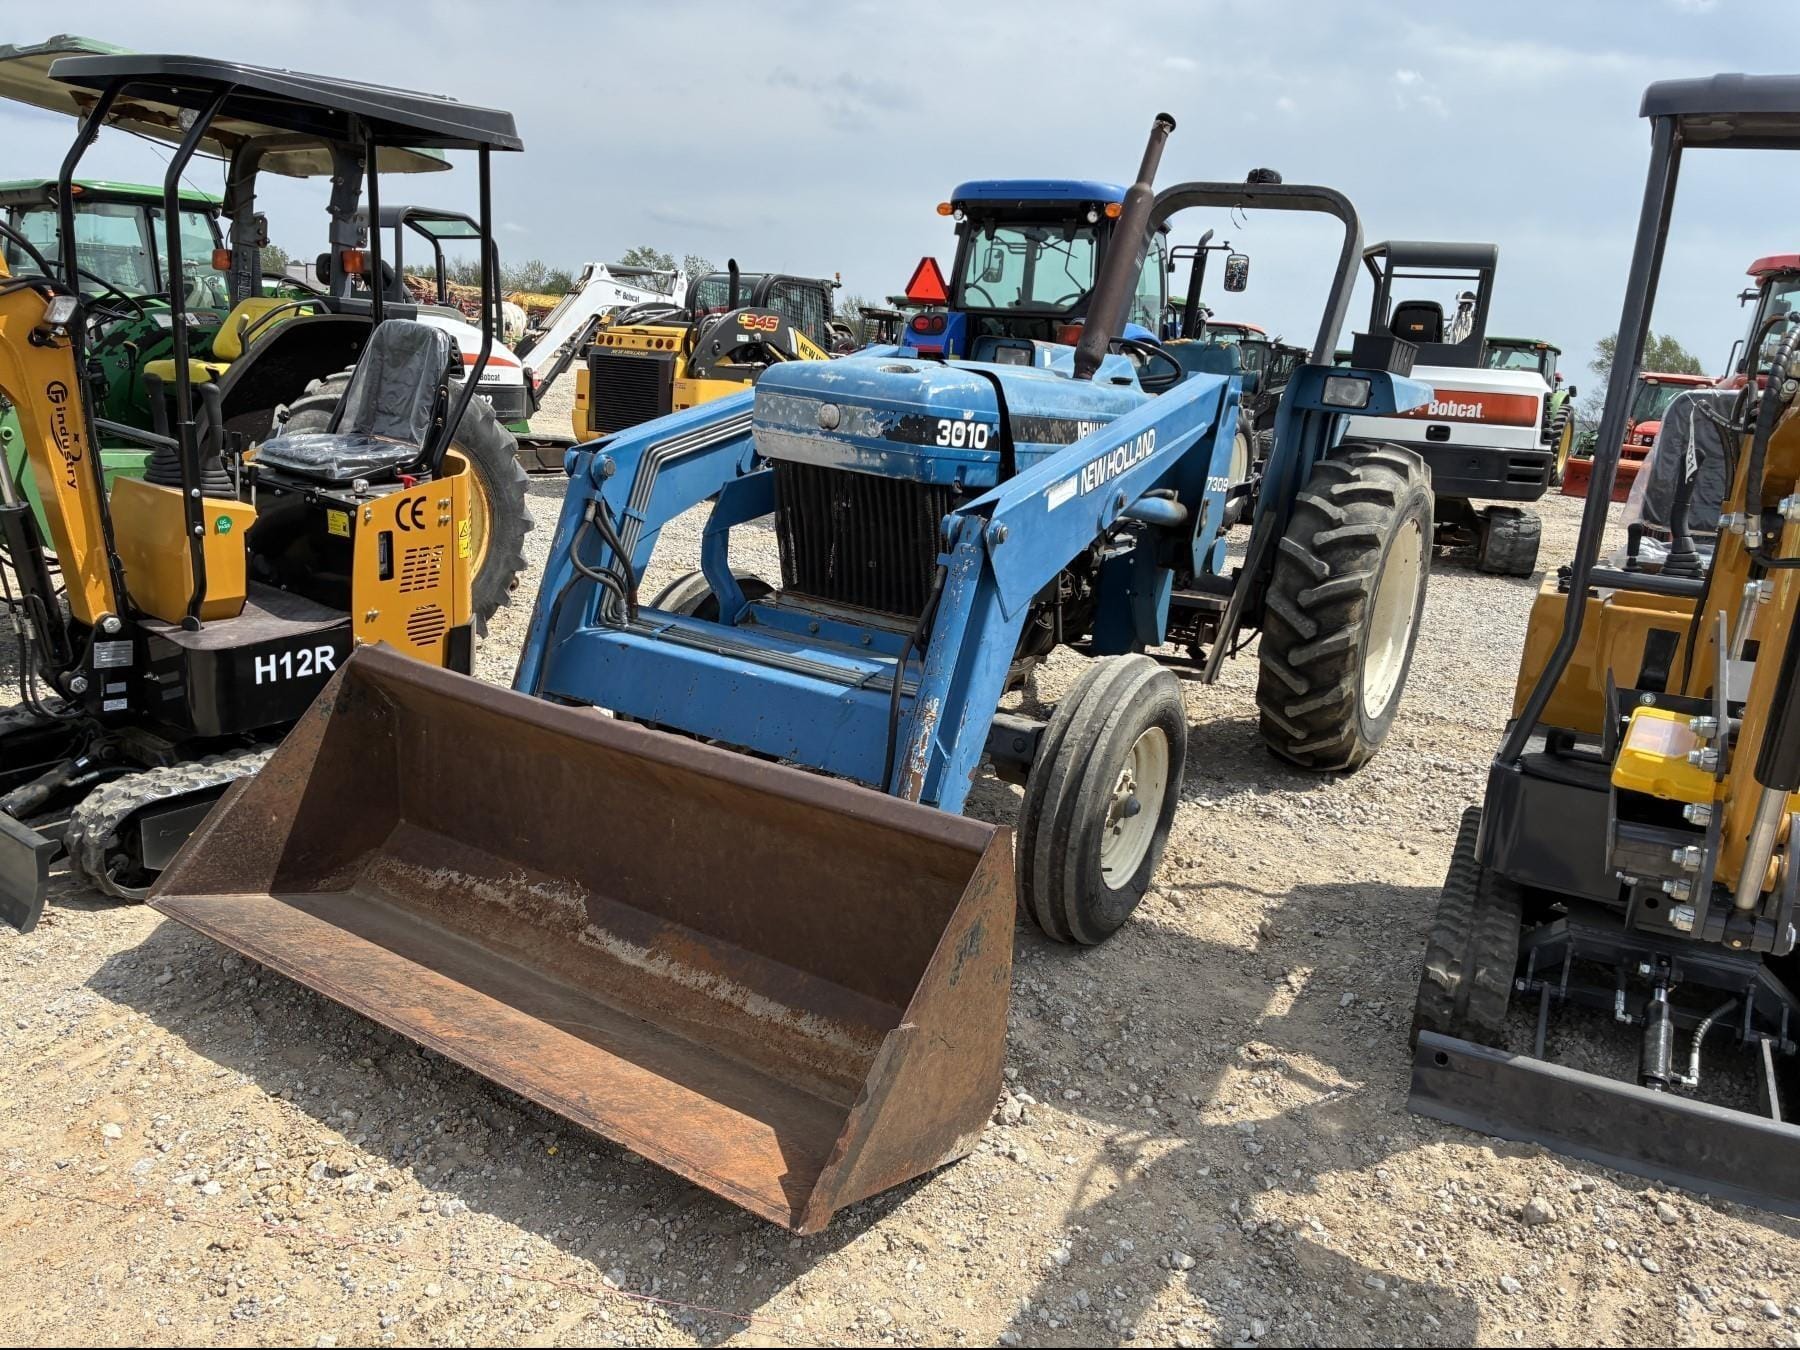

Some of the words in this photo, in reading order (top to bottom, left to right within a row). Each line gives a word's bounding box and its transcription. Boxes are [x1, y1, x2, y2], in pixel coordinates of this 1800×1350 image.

[622, 292, 639, 303] Bobcat
[800, 342, 815, 360] NEW
[1428, 400, 1482, 418] Bobcat
[936, 419, 988, 449] 3010
[1080, 458, 1108, 497] NEW
[1107, 429, 1156, 481] HOLLAND
[255, 645, 336, 685] H12R
